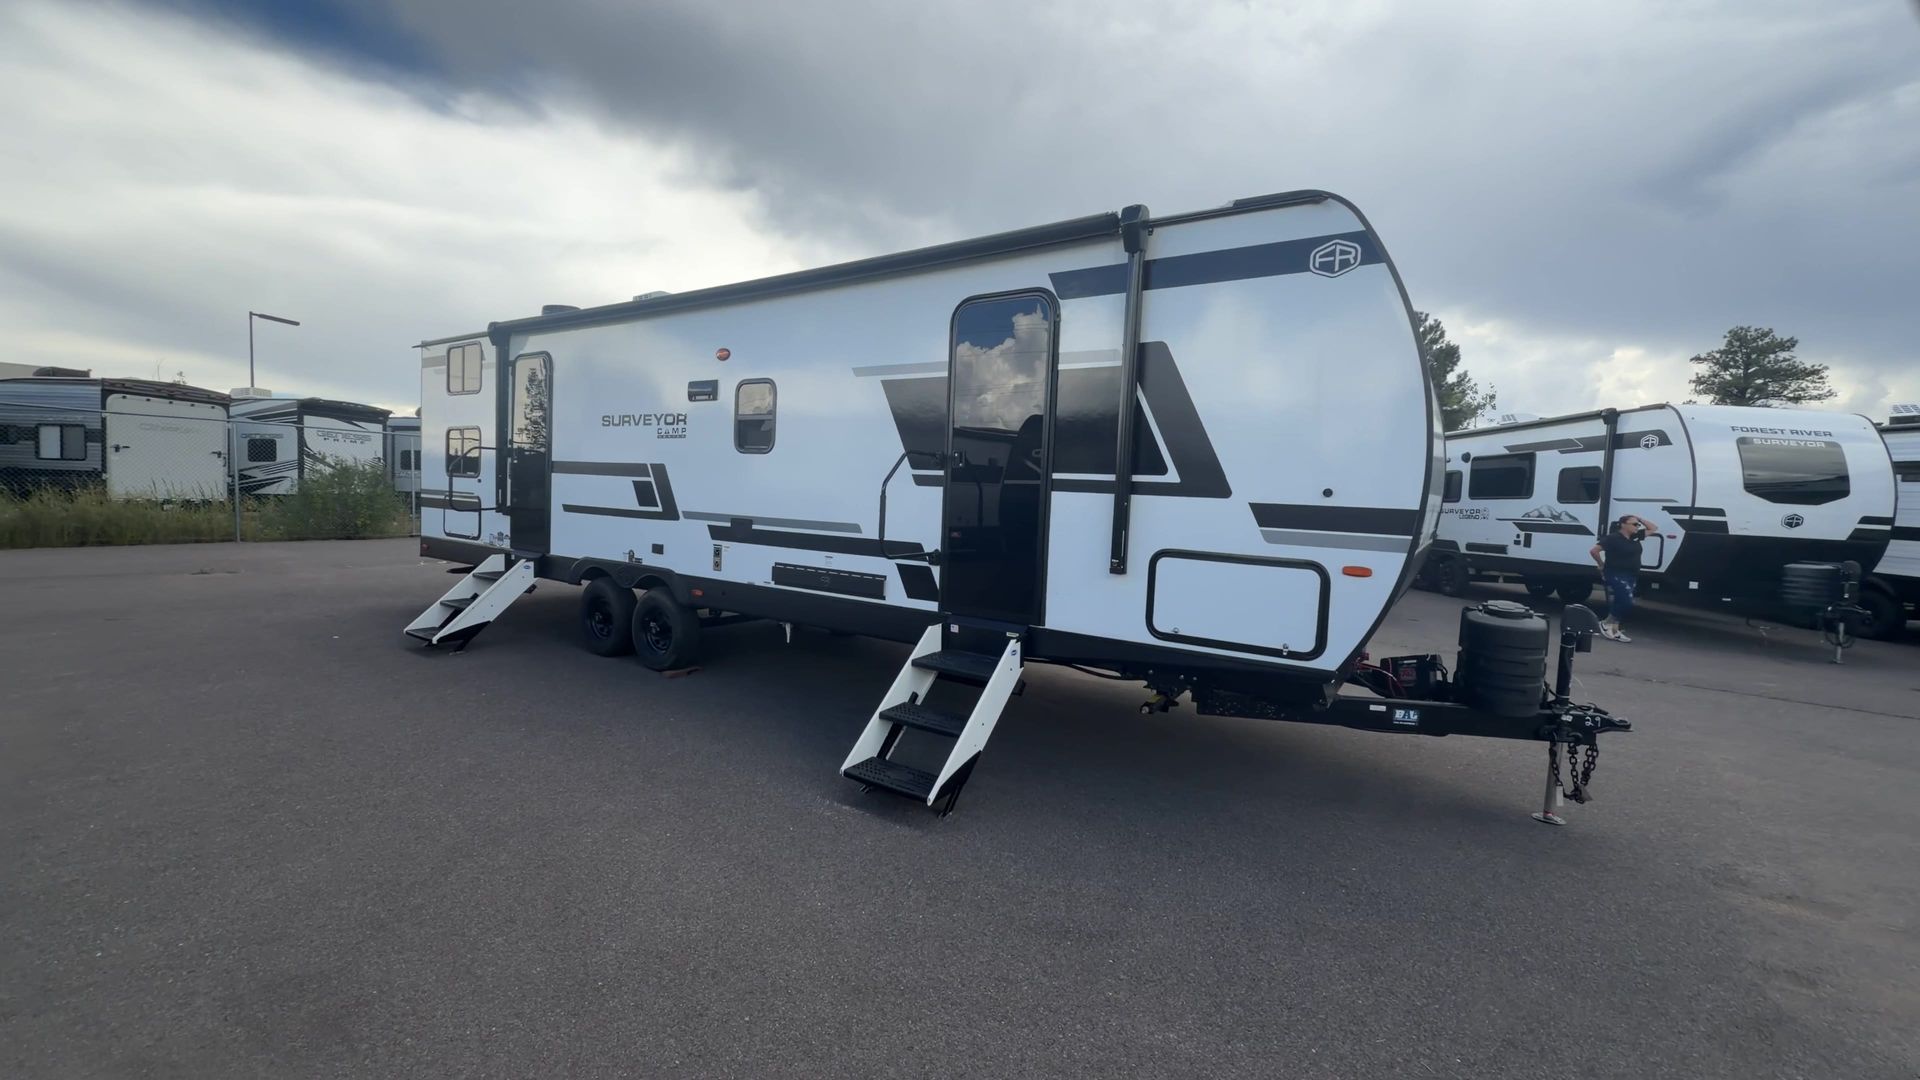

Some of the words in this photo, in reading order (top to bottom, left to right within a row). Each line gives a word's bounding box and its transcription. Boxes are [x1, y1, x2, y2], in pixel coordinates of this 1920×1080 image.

[601, 413, 687, 427] SURVEYOR
[657, 427, 687, 435] CAMP
[1729, 425, 1786, 435] FOREST
[1789, 429, 1833, 437] RIVER
[1752, 438, 1826, 448] SURVEYOR
[1584, 716, 1601, 728] 29
